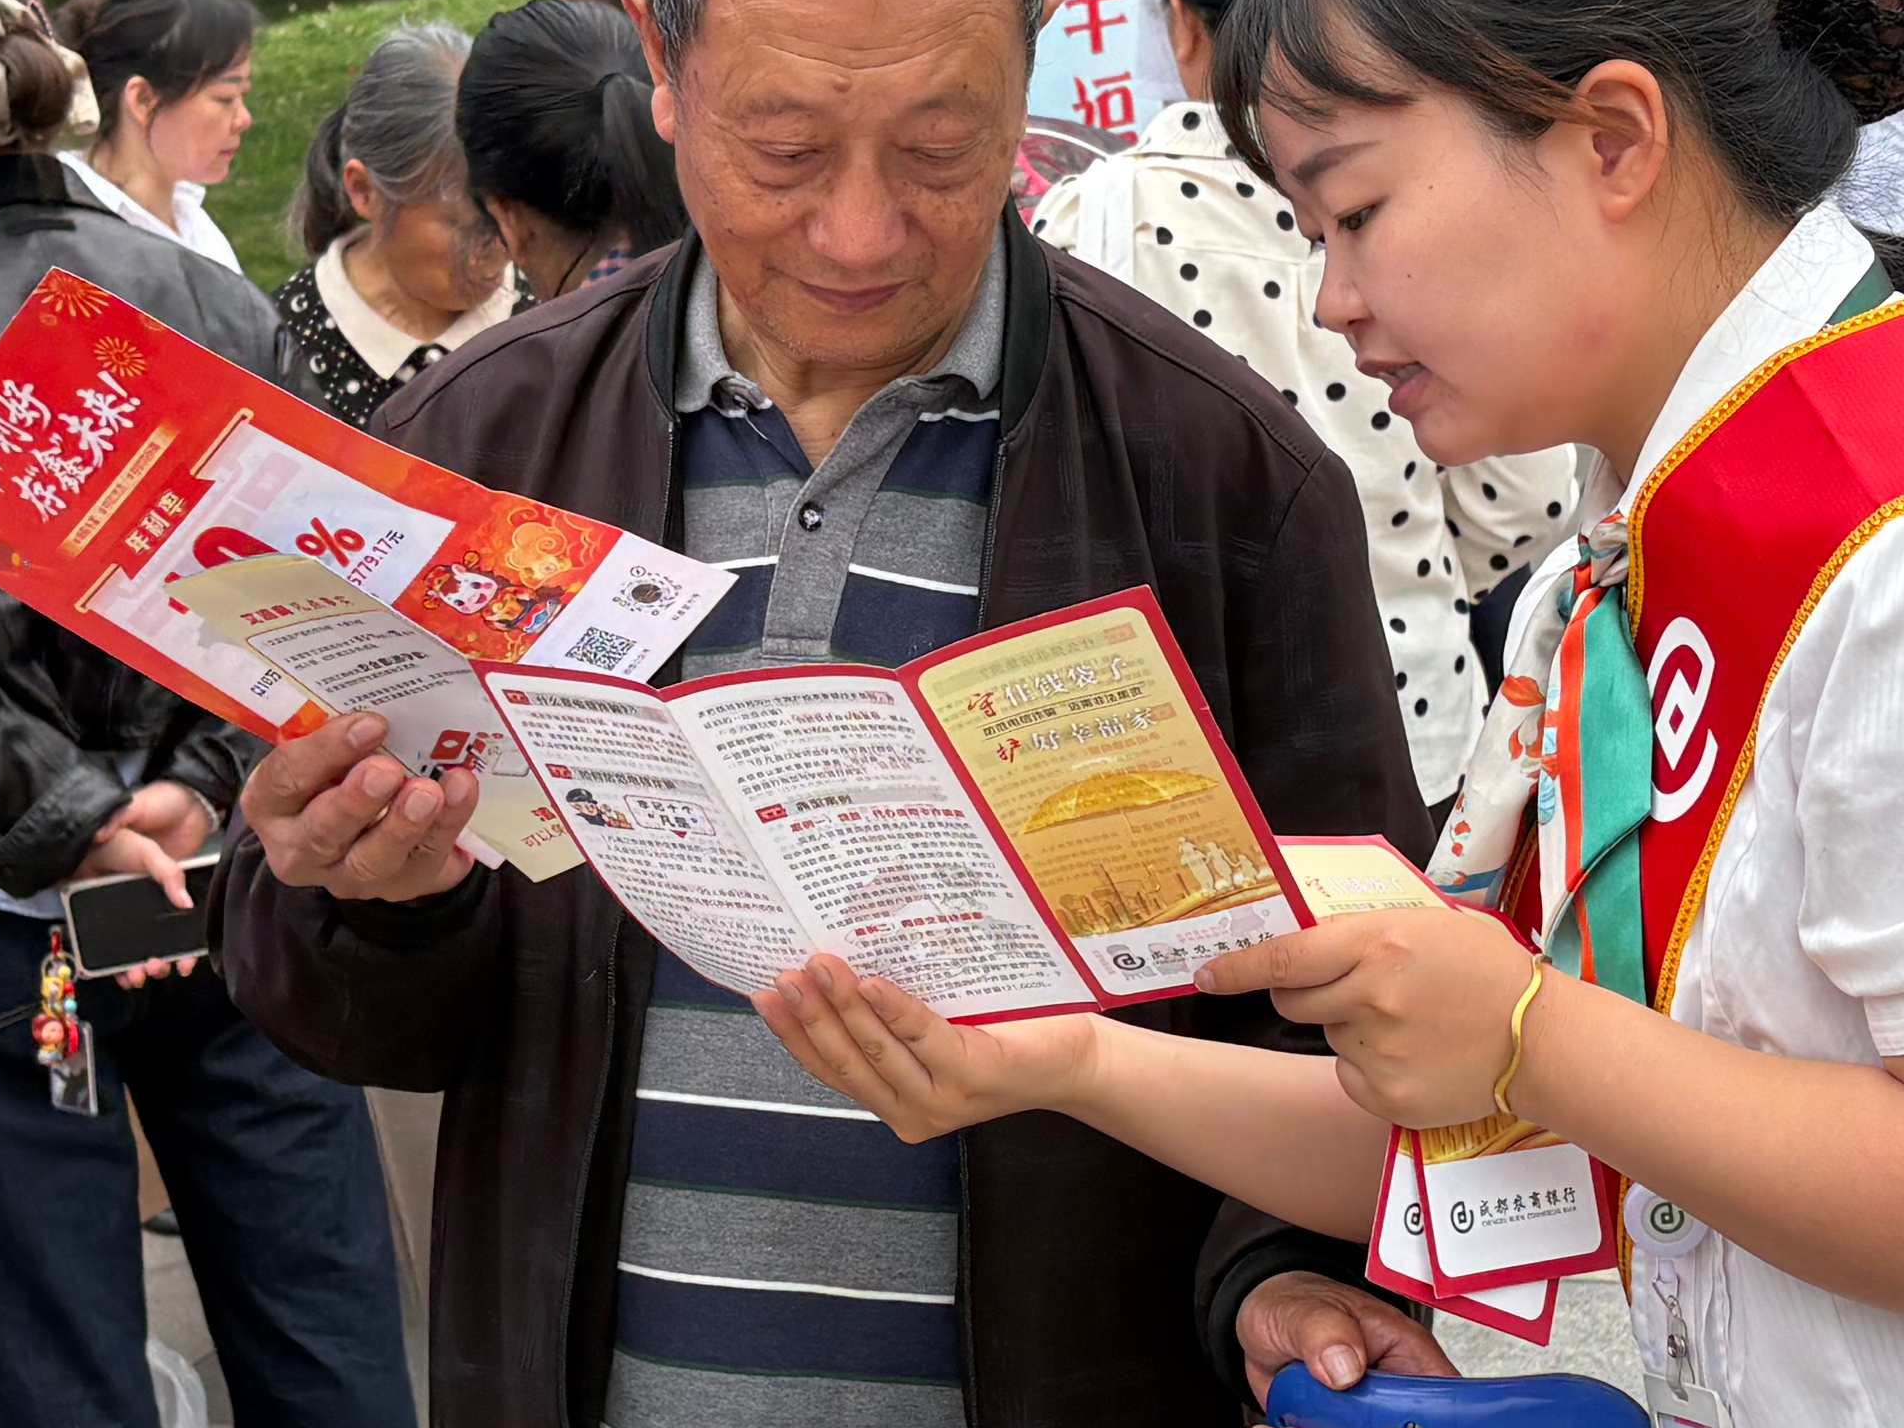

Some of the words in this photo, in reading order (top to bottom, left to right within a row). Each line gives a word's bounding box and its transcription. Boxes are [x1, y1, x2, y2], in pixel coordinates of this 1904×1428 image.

[124, 490, 186, 556] 年利率
[967, 656, 1128, 718] 守住钱袋子
